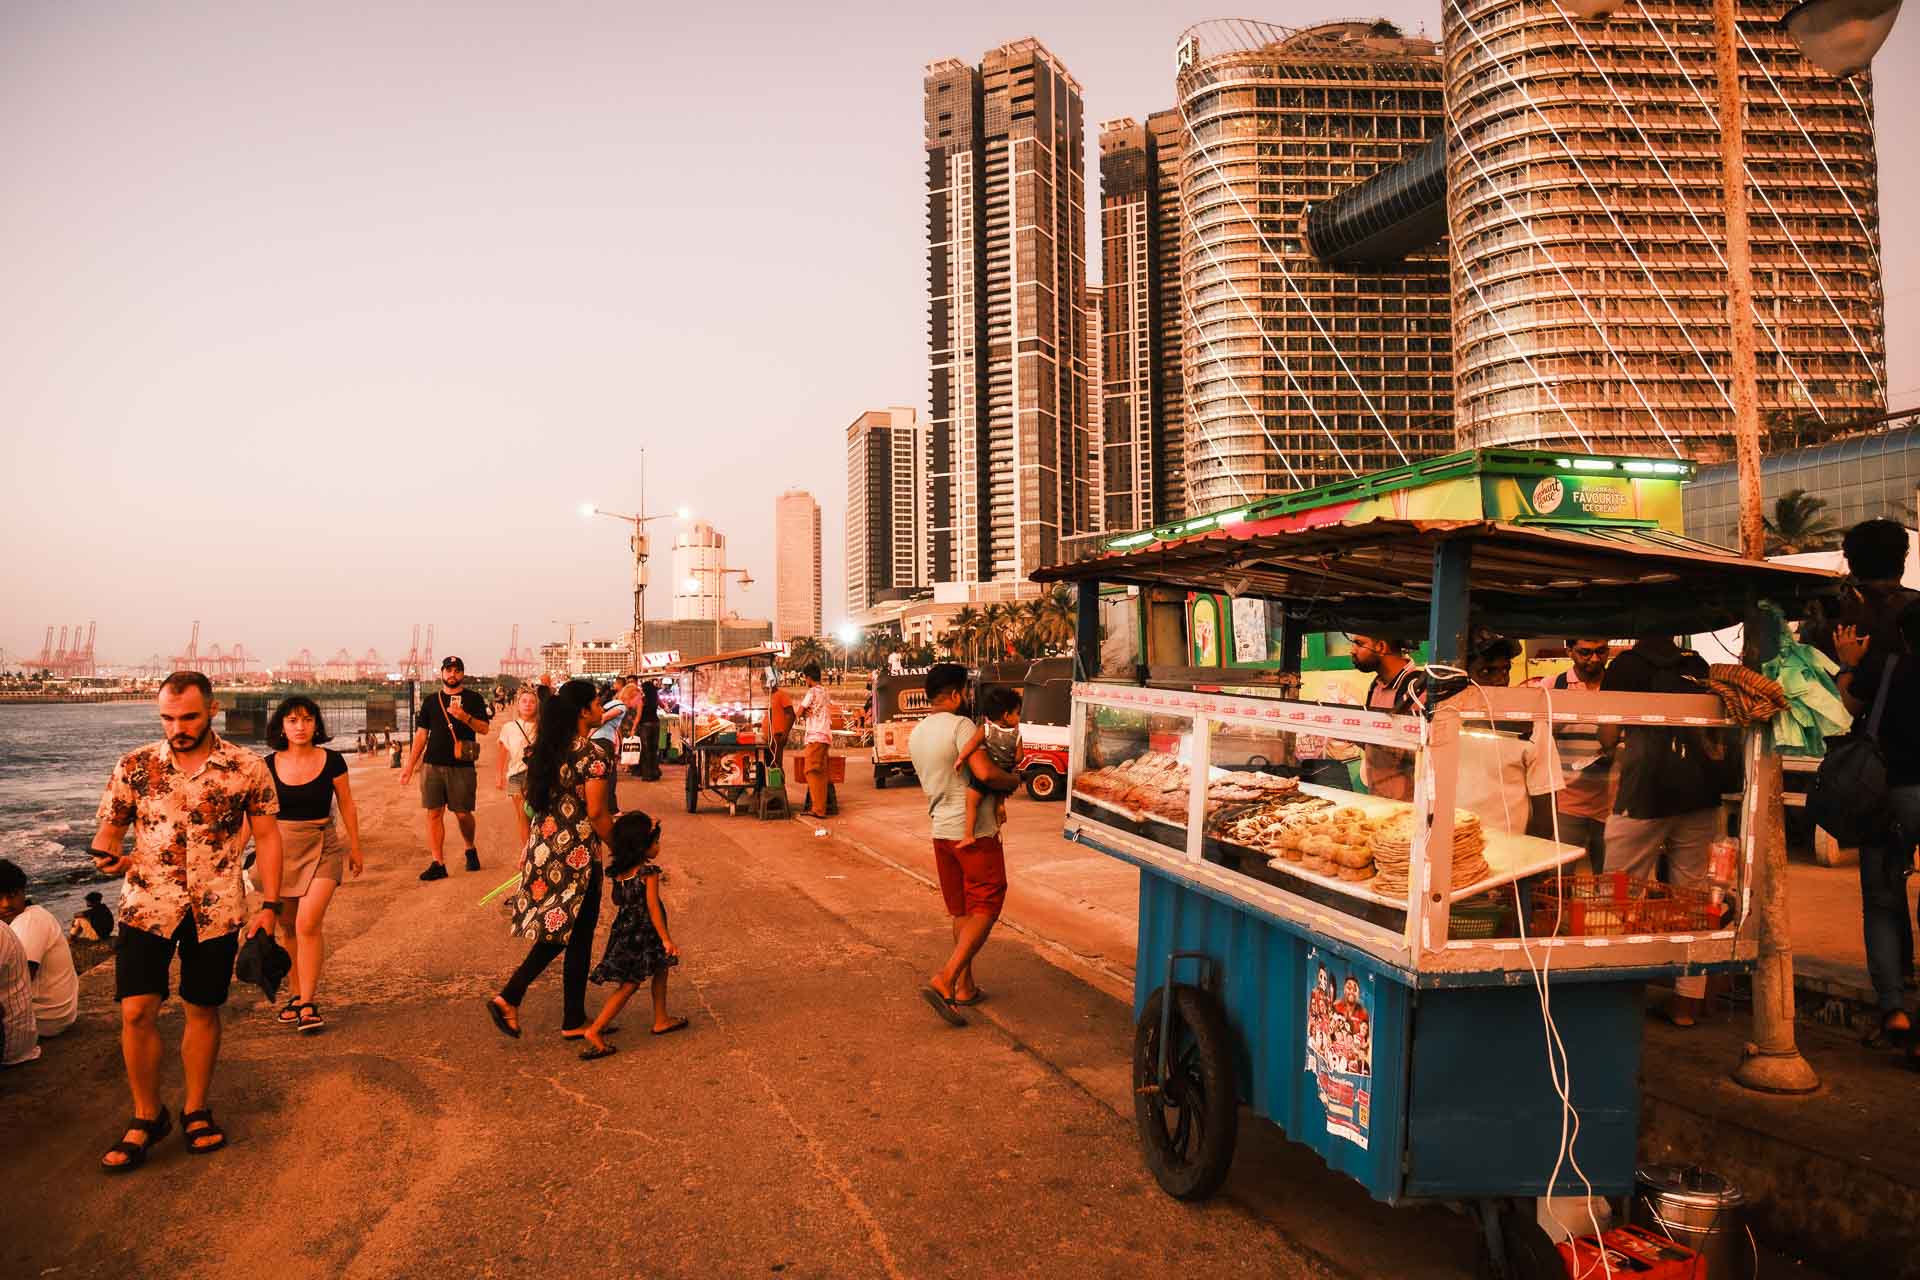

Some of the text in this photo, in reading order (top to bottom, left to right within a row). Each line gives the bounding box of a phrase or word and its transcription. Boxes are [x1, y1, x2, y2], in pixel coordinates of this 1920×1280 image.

[1573, 491, 1626, 504] FAVOURITE
[1583, 504, 1622, 513] ICE CREAM
